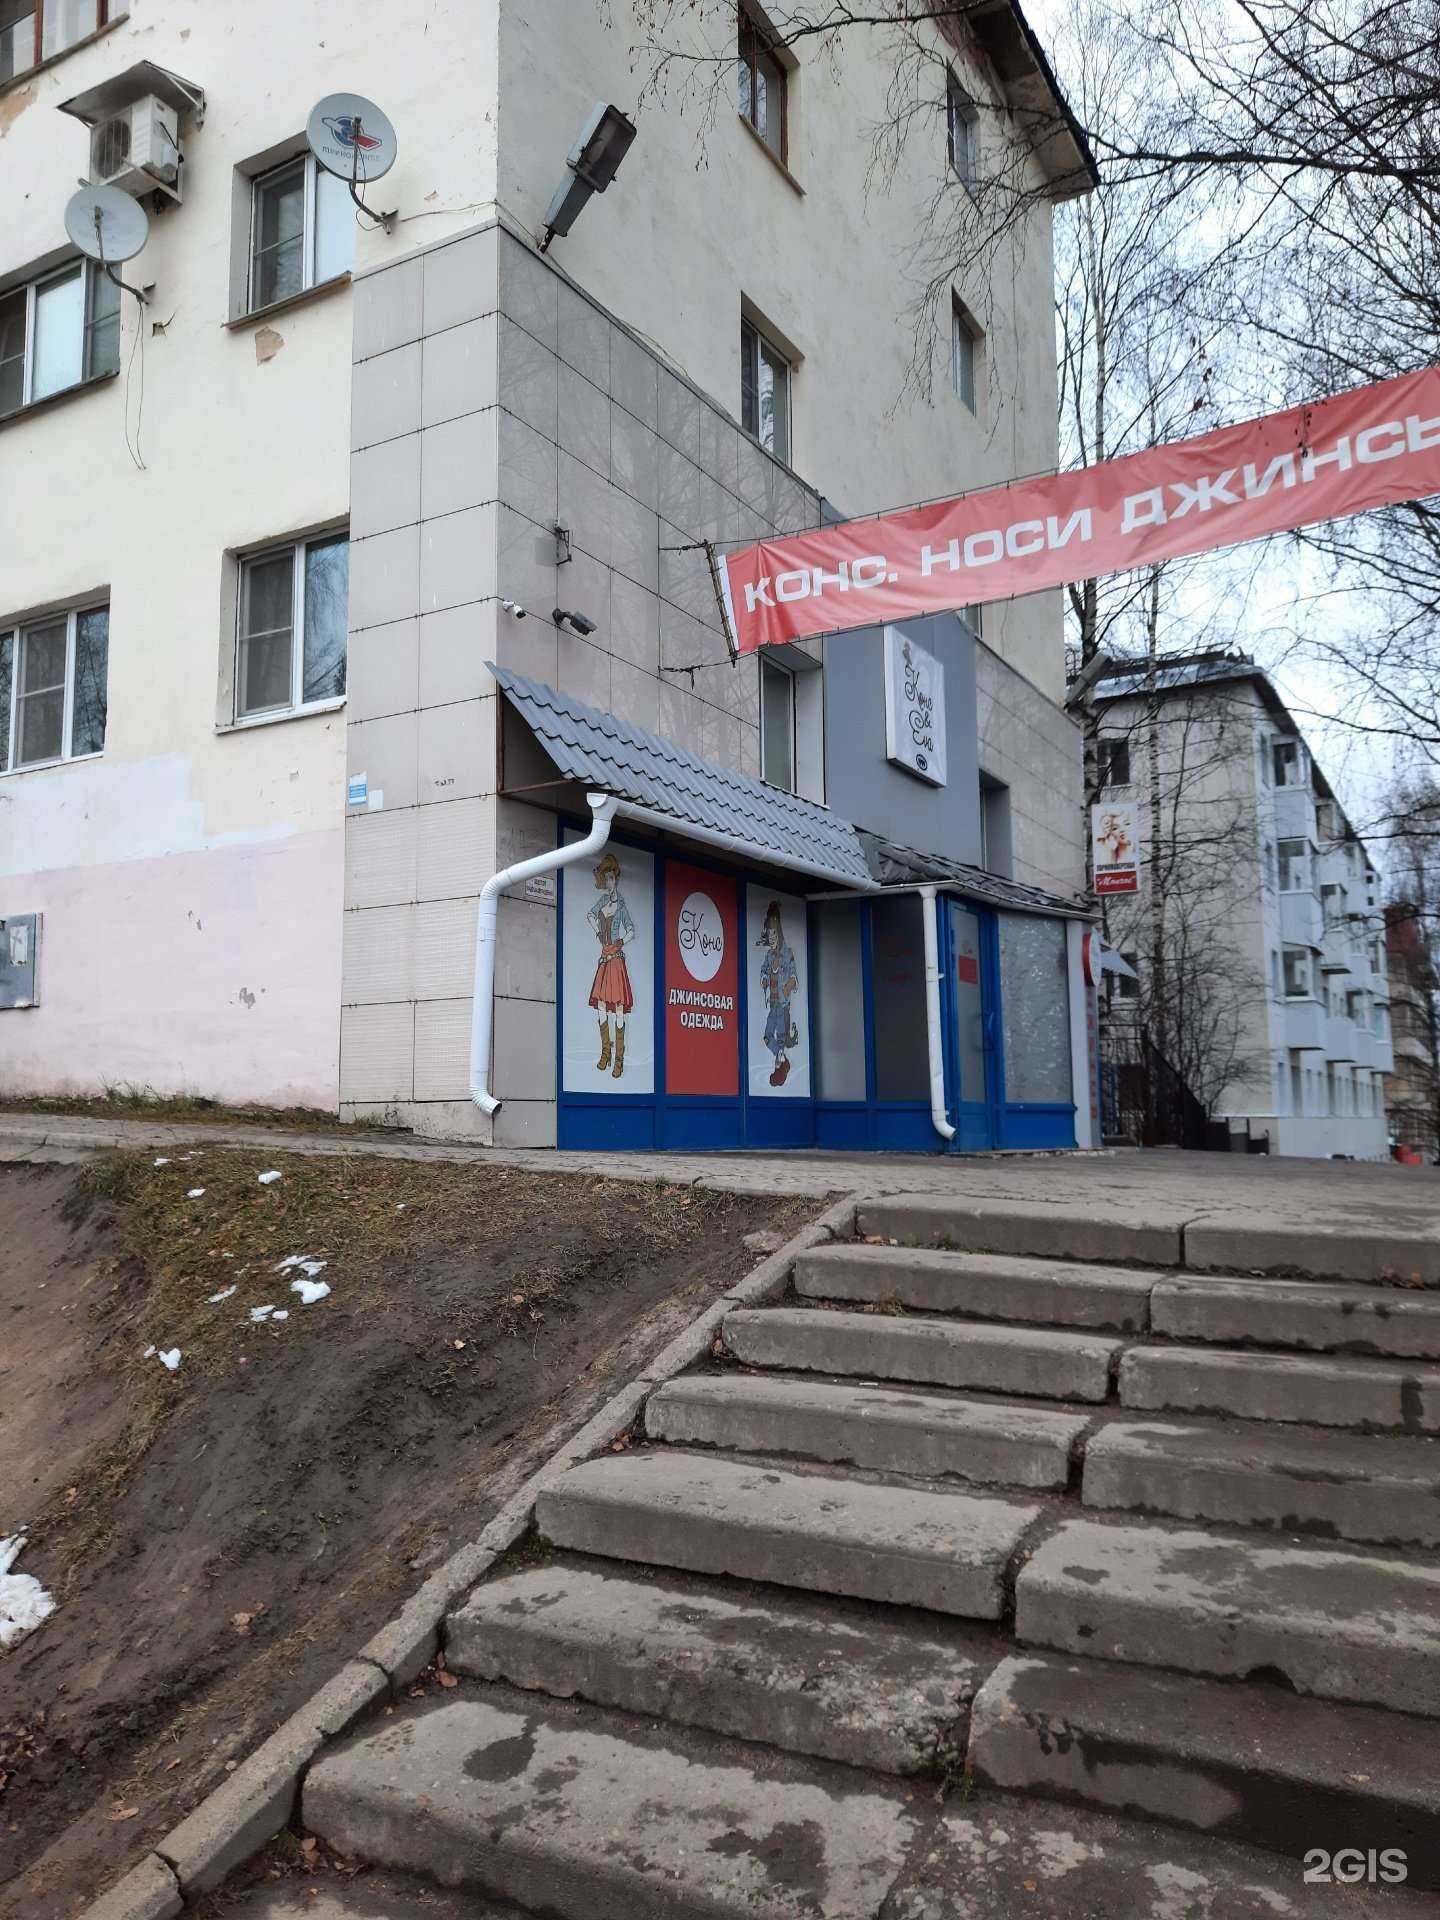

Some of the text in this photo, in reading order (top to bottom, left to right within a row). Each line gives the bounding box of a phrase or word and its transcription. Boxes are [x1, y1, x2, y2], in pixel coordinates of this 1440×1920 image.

[743, 555, 898, 613] КОНС.
[921, 508, 1092, 577] НОСИ
[680, 910, 722, 956] Конс
[669, 988, 733, 1010] ДЖИНСОВАЯ
[680, 1011, 724, 1030] ОДЕЖДА
